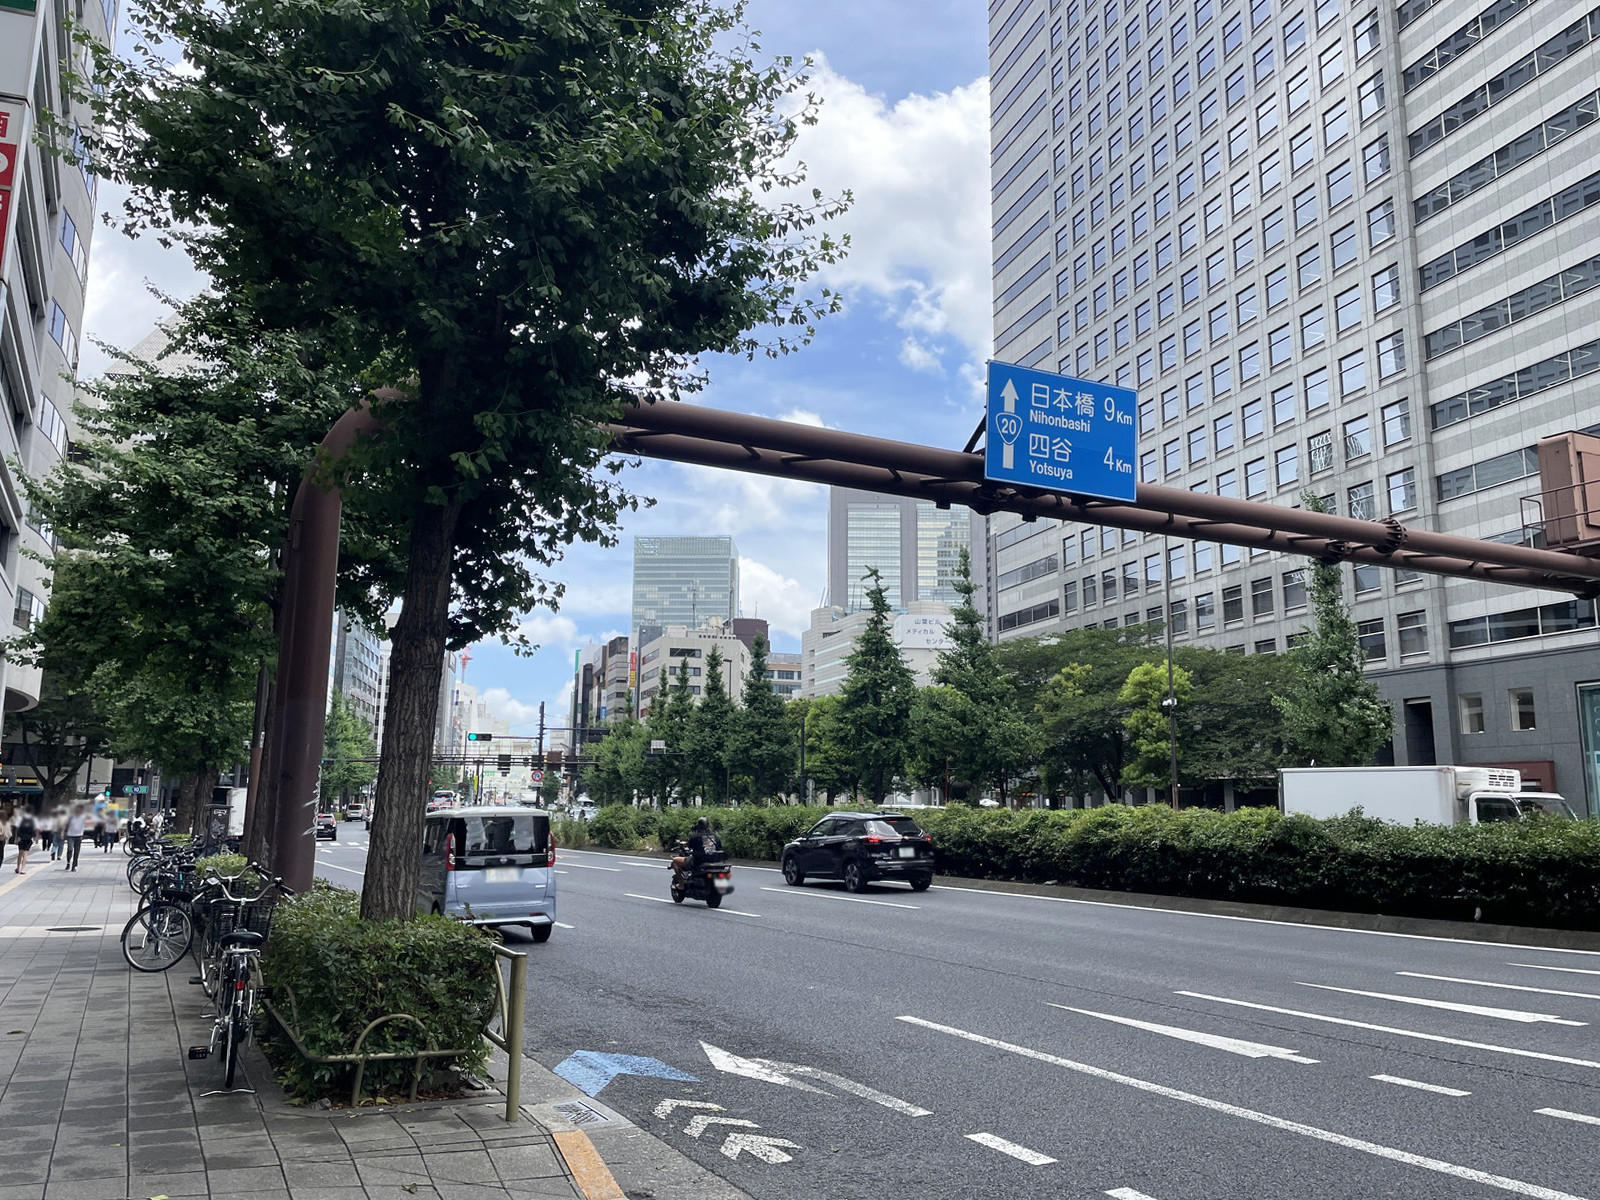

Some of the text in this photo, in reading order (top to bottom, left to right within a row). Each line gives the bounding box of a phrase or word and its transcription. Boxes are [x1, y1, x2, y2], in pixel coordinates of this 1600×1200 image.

[1031, 383, 1095, 417] 日本橋
[1001, 418, 1017, 435] 20
[1029, 409, 1091, 432] Nihonbashi
[1029, 433, 1072, 463] 四谷
[1029, 460, 1073, 480] Yotsuya
